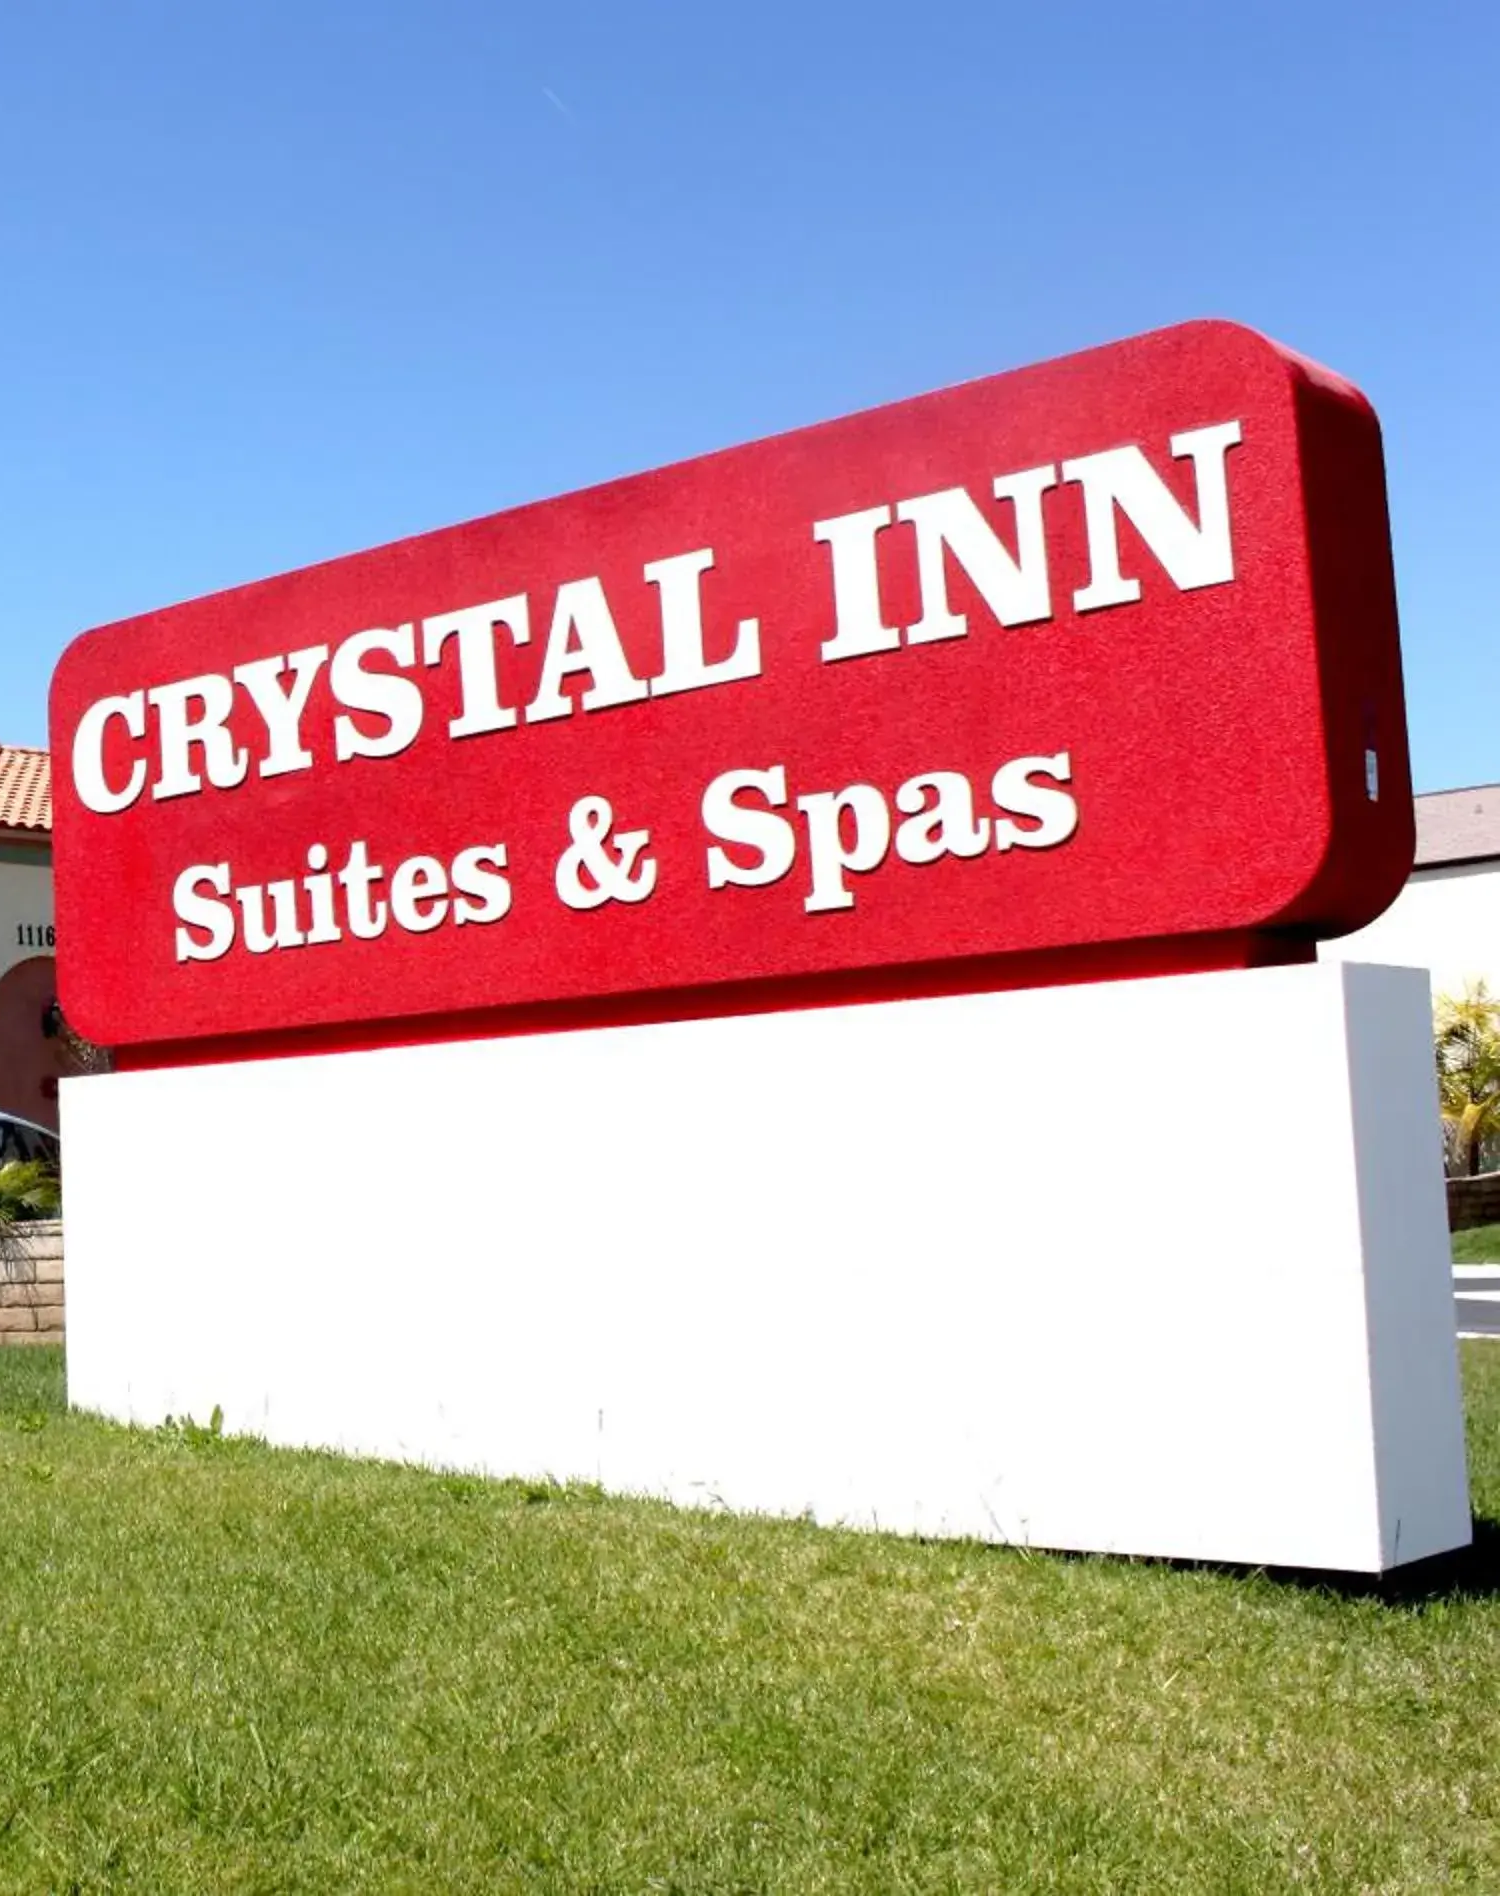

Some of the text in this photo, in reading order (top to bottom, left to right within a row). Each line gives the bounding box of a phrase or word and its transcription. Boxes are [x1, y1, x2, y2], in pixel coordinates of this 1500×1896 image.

[71, 418, 1243, 814] CRYSTAL INN
[172, 750, 1079, 962] Suites & Spas
